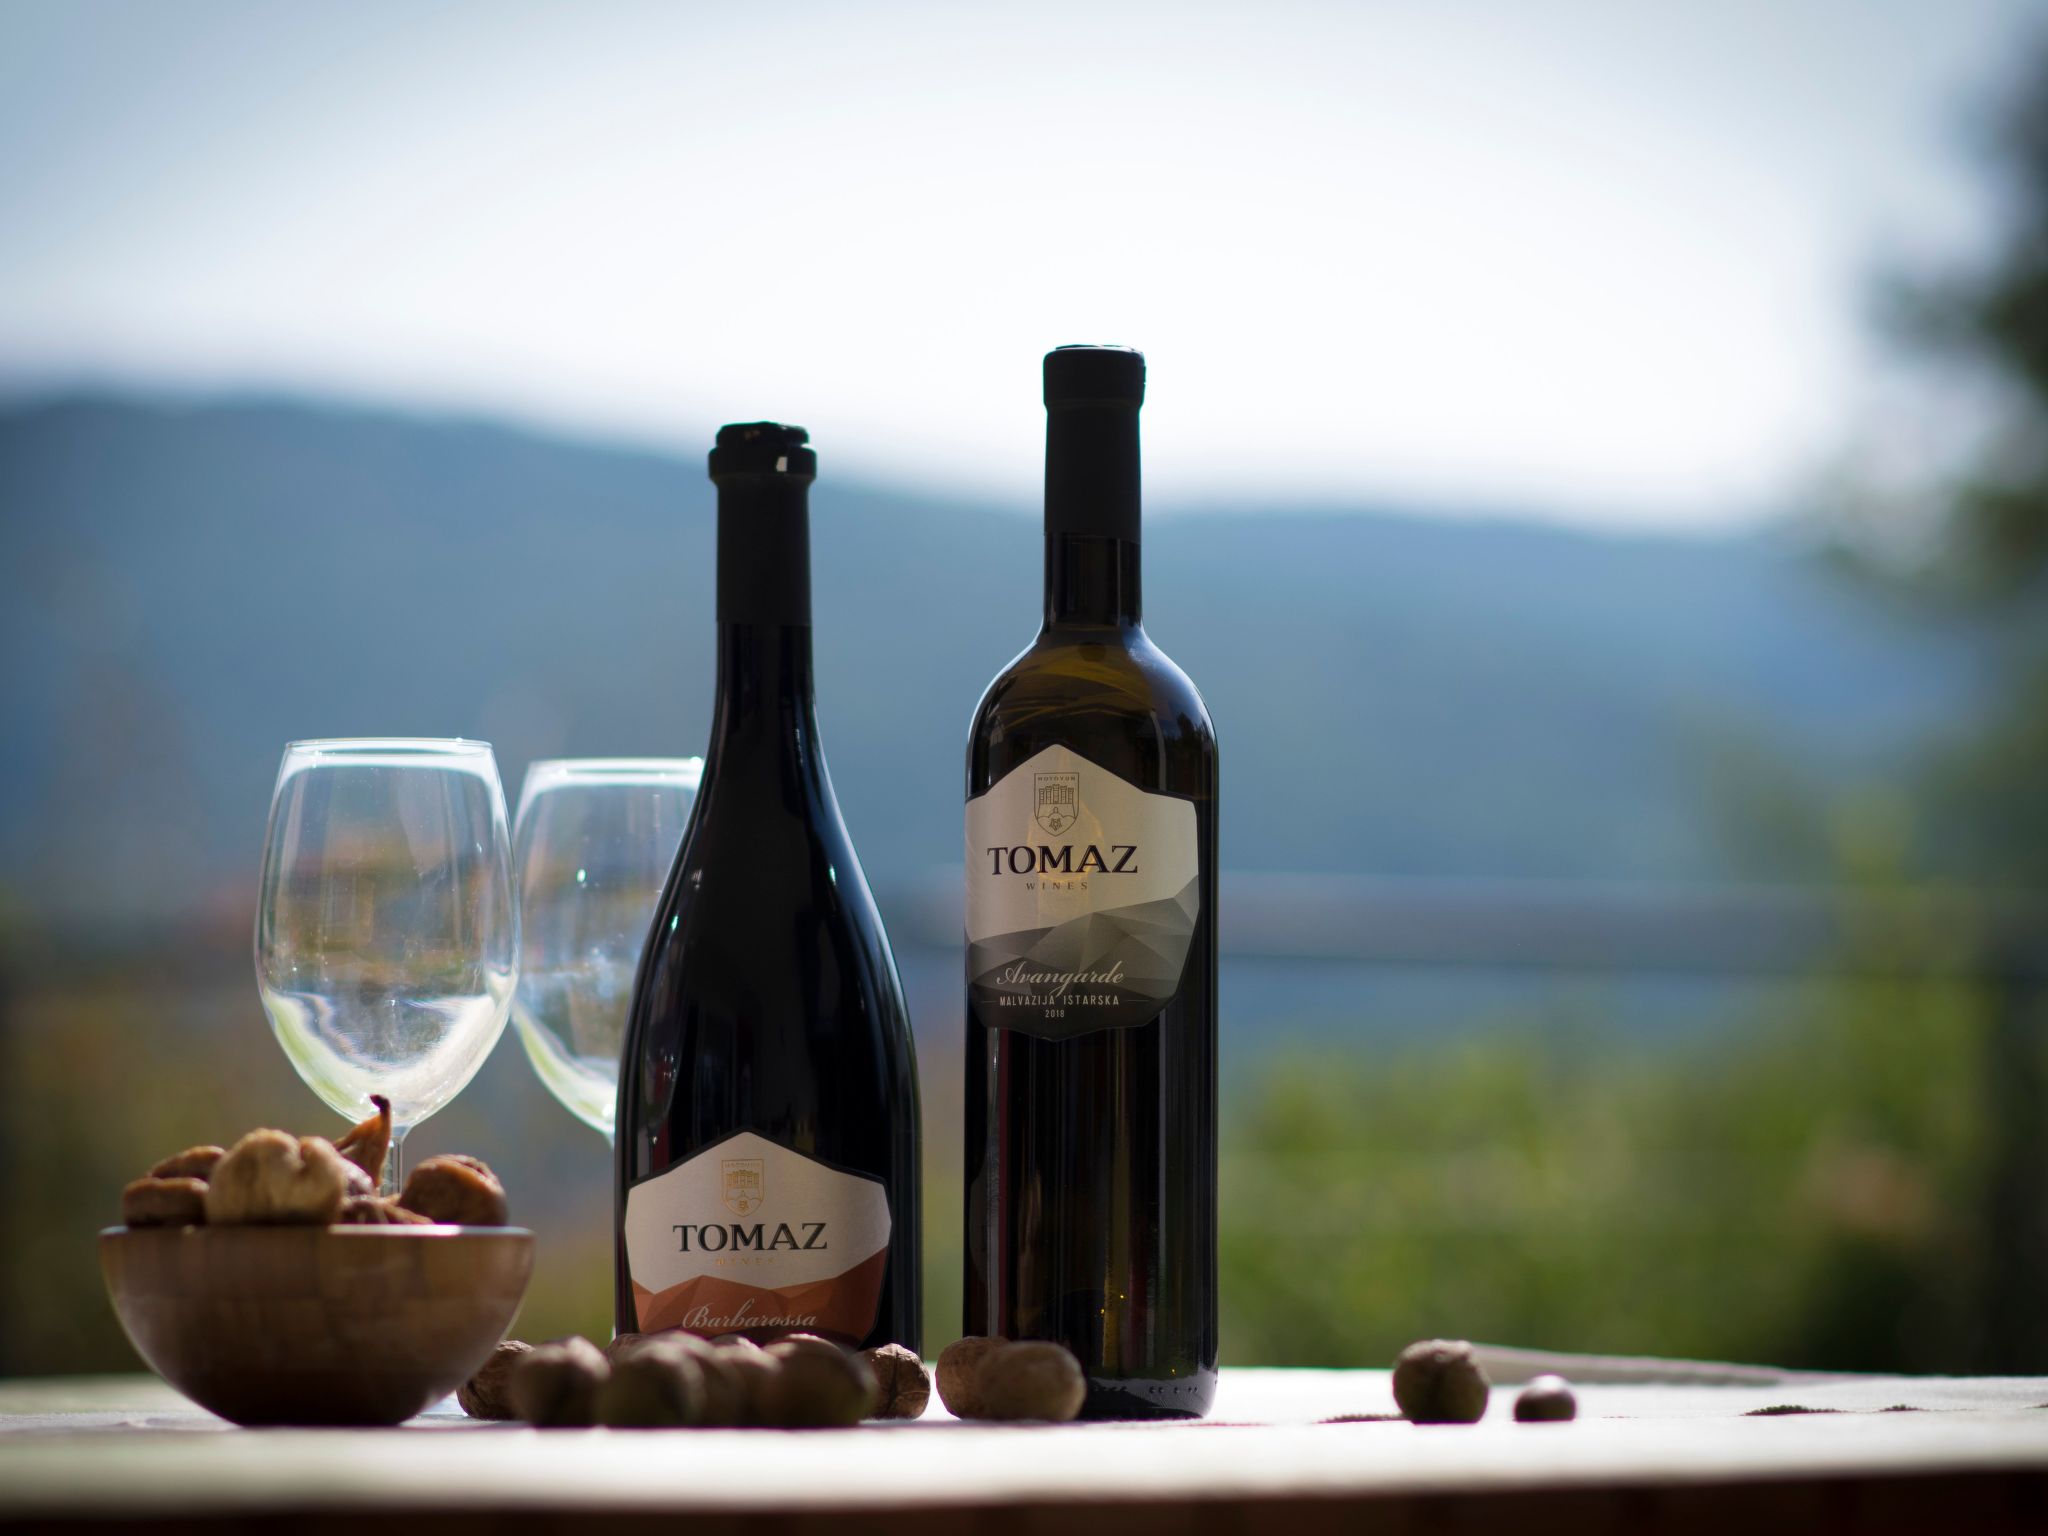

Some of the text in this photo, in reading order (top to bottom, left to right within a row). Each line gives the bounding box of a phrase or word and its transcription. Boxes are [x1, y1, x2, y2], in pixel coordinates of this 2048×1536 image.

[987, 845, 1138, 875] TOMAZ
[1026, 881, 1088, 890] WINES
[996, 961, 1124, 996] Avangarde
[999, 995, 1119, 1007] MALVAZIJA ISTARSKA
[1045, 1009, 1065, 1018] 2018
[672, 1223, 828, 1252] TOMAZ
[682, 1298, 817, 1328] Barbarossa
